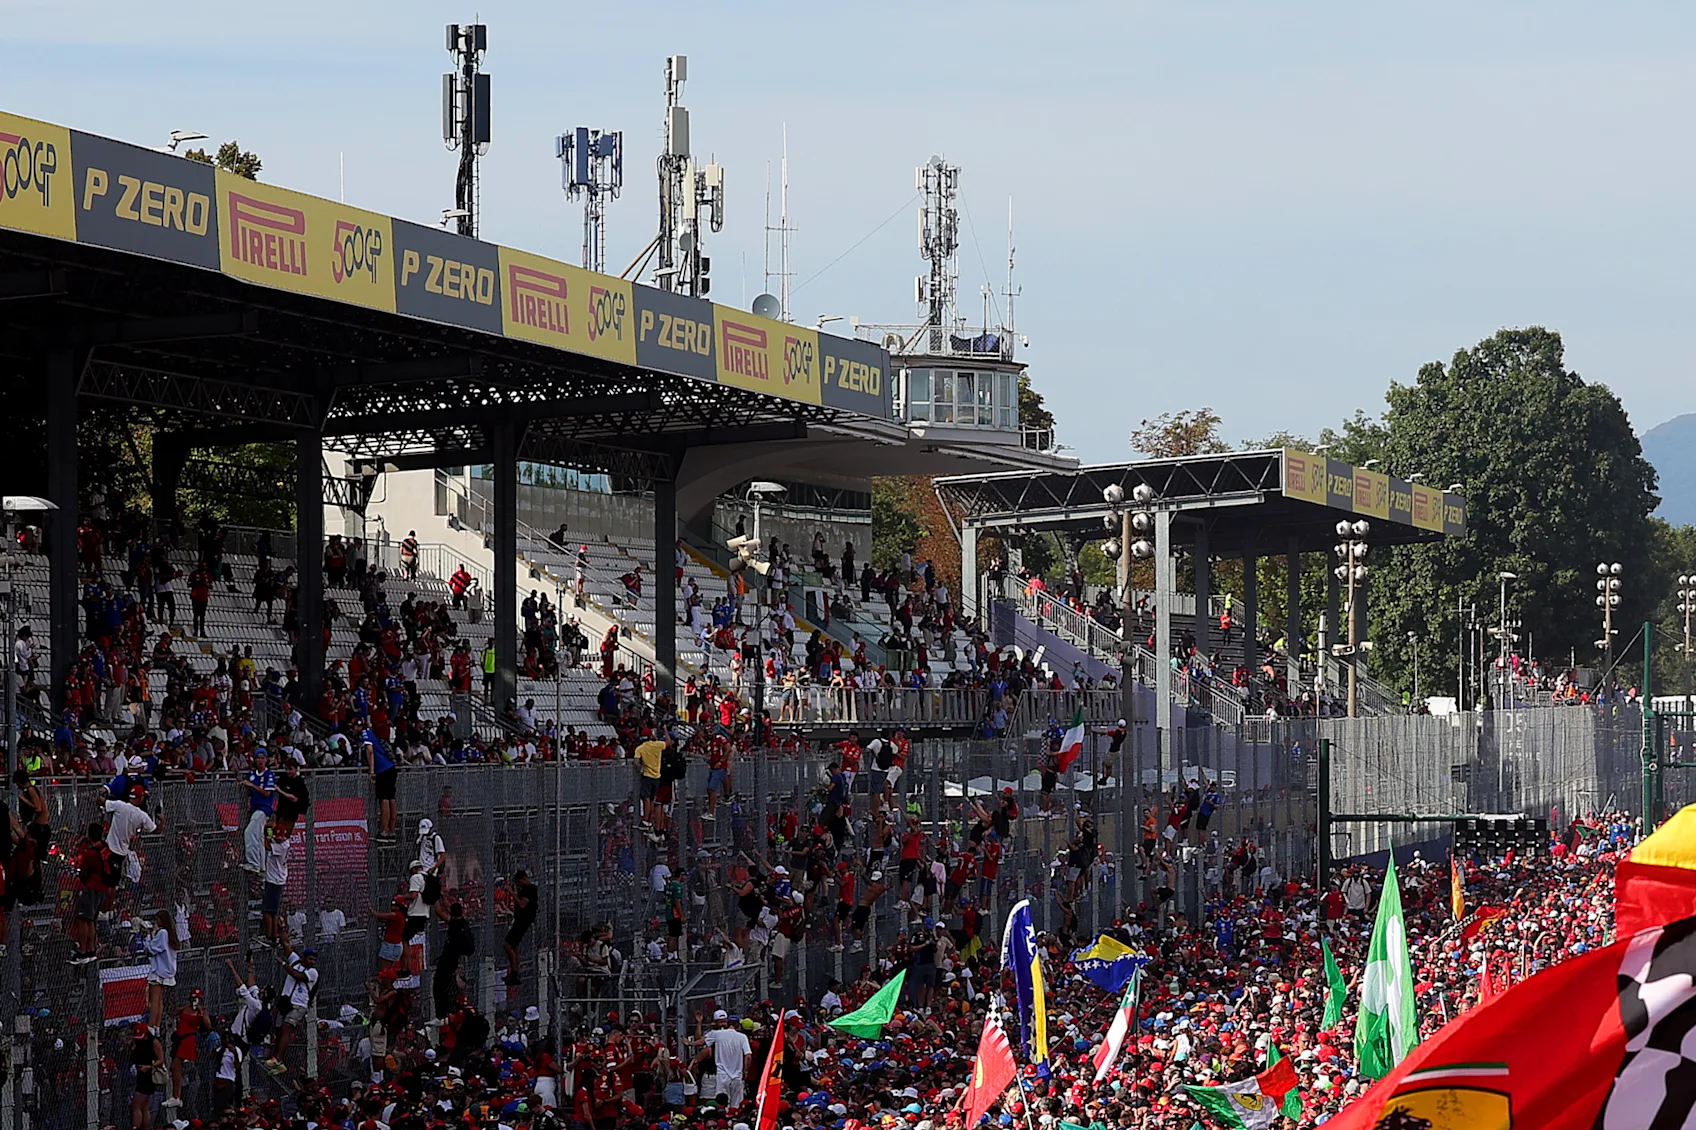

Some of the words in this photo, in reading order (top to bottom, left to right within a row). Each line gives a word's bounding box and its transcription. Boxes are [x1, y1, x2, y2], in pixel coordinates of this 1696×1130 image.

[83, 168, 108, 211] P
[115, 175, 210, 236] ZERO
[228, 191, 308, 276] PIRELLI
[401, 250, 420, 287] P
[424, 255, 494, 306] ZERO
[509, 264, 569, 335] PIRELLI
[639, 309, 655, 342] P
[657, 314, 711, 356] ZERO
[722, 320, 769, 381] PIRELLI
[824, 355, 836, 385] P
[836, 360, 881, 396] ZERO
[1288, 457, 1305, 492] PIRELLI
[1328, 475, 1334, 493] P
[1333, 475, 1352, 498] ZERO
[1395, 491, 1411, 513] ZERO
[1448, 504, 1462, 525] ZERO
